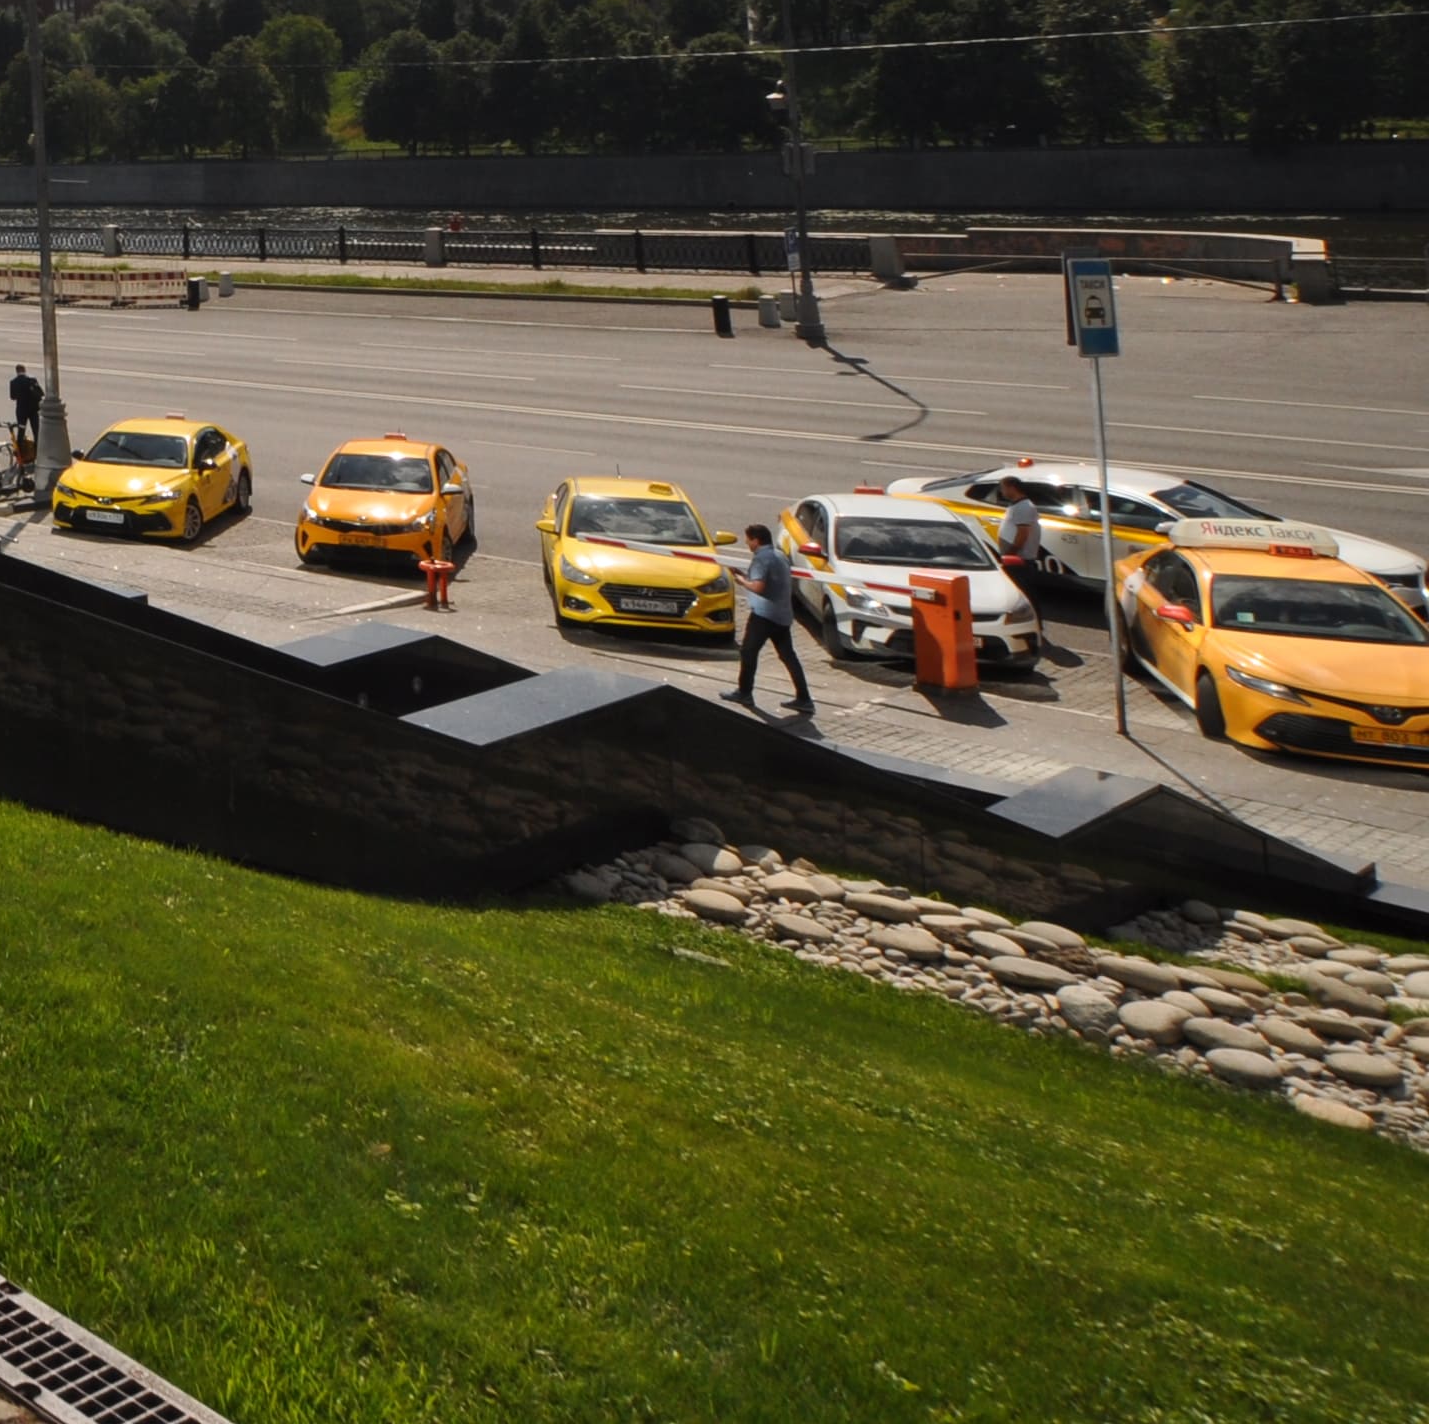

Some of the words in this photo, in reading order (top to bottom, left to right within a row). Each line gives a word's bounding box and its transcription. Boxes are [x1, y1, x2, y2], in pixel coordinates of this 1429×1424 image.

[1079, 279, 1105, 290] ТАКСИ
[1200, 521, 1264, 538] Яндекс
[1267, 524, 1317, 542] Такси
